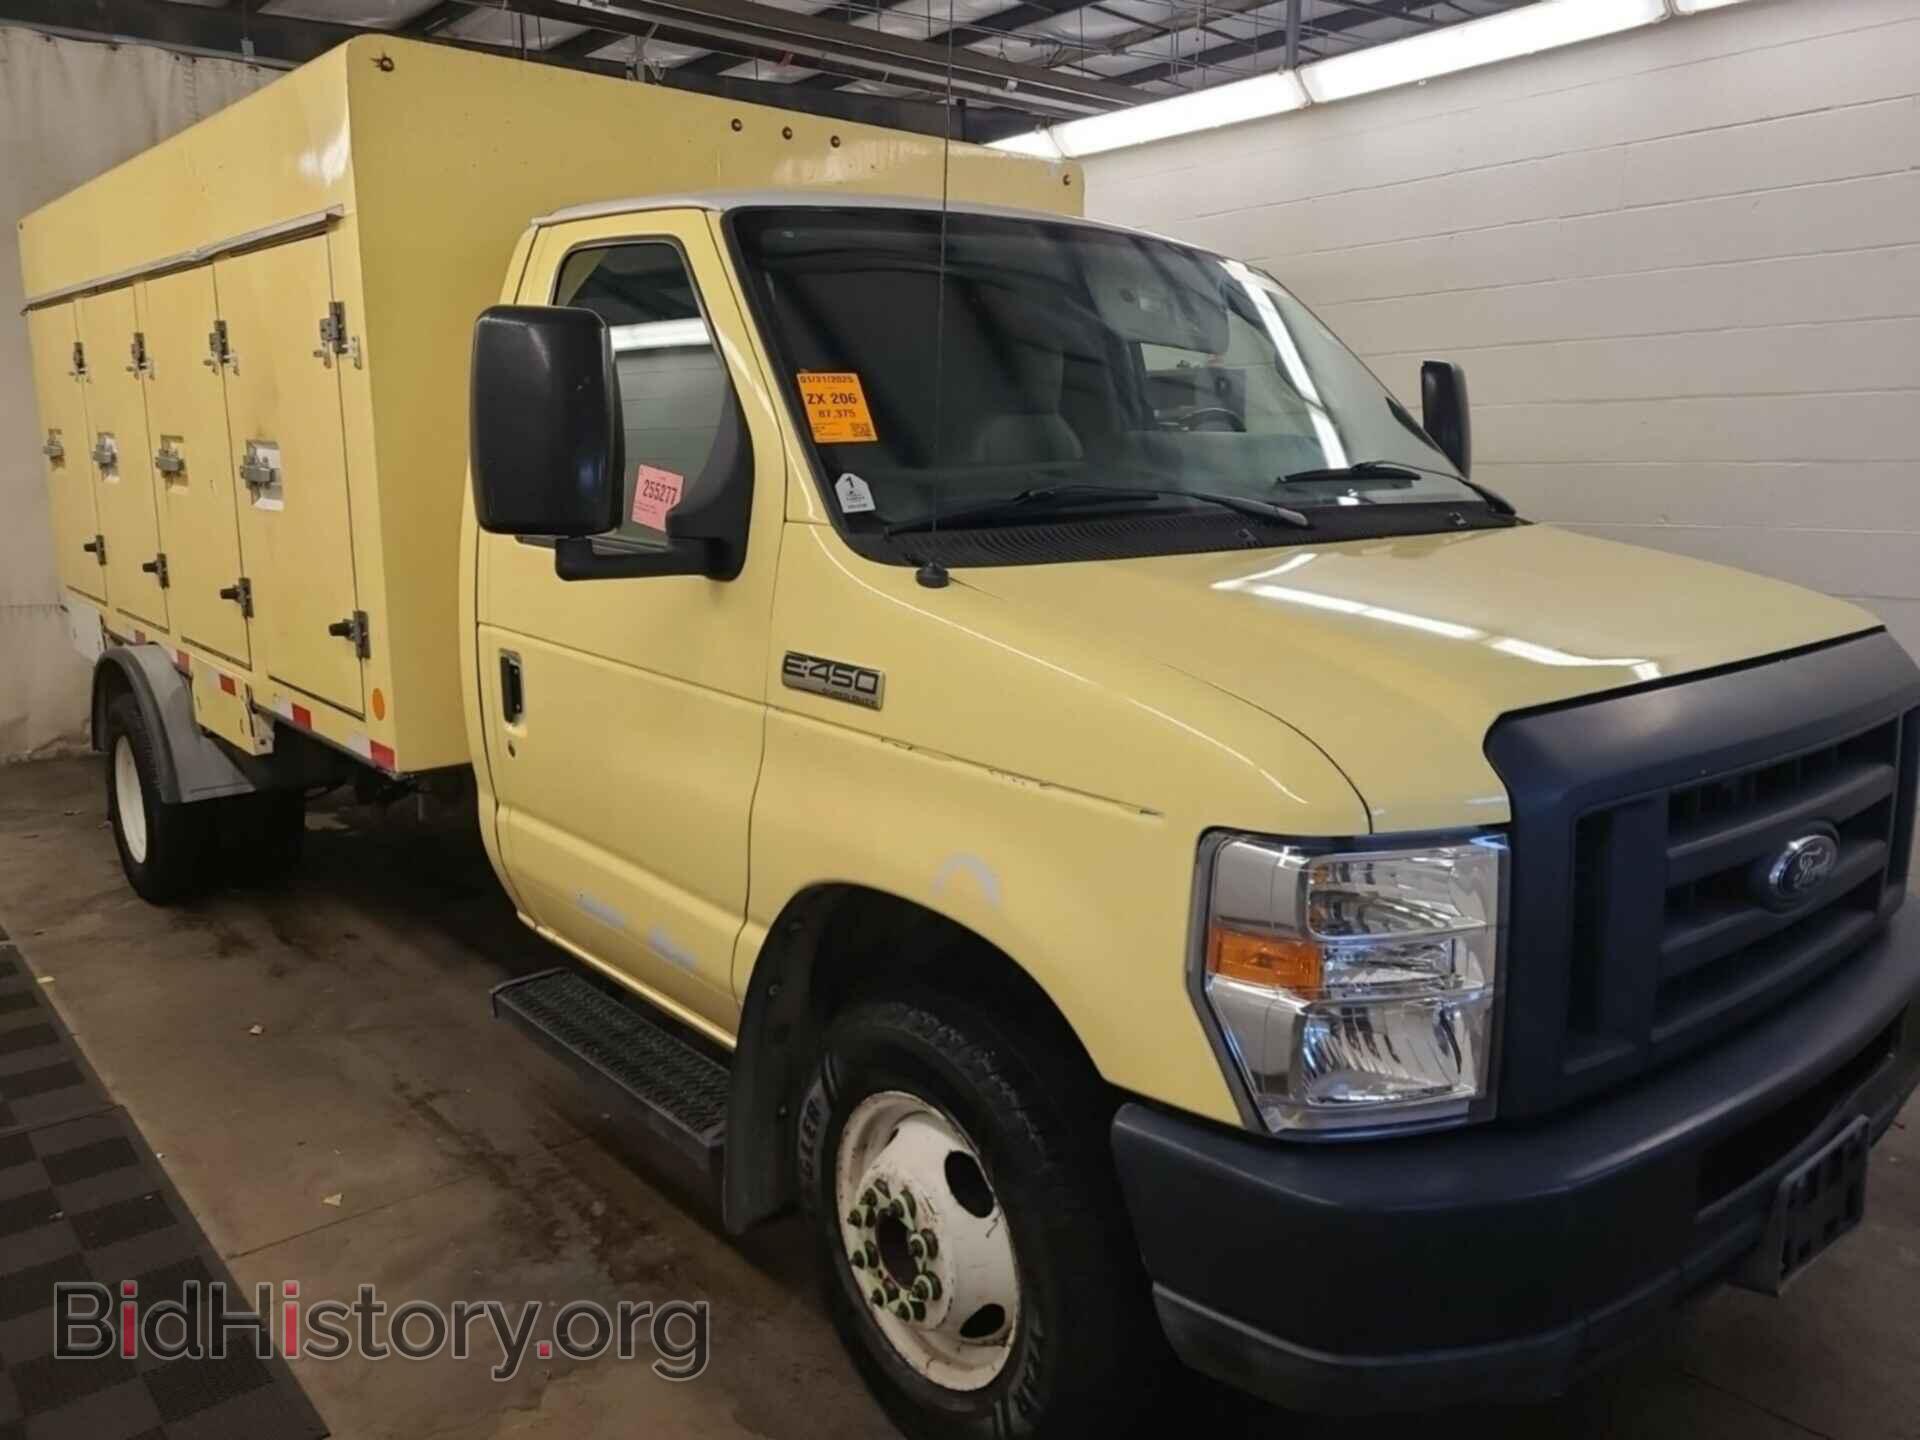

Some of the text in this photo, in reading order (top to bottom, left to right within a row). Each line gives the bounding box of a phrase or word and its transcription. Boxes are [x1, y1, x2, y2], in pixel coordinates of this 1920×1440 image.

[806, 392, 857, 405] ZX 206
[642, 479, 678, 505] 255277
[783, 654, 879, 694] E-450
